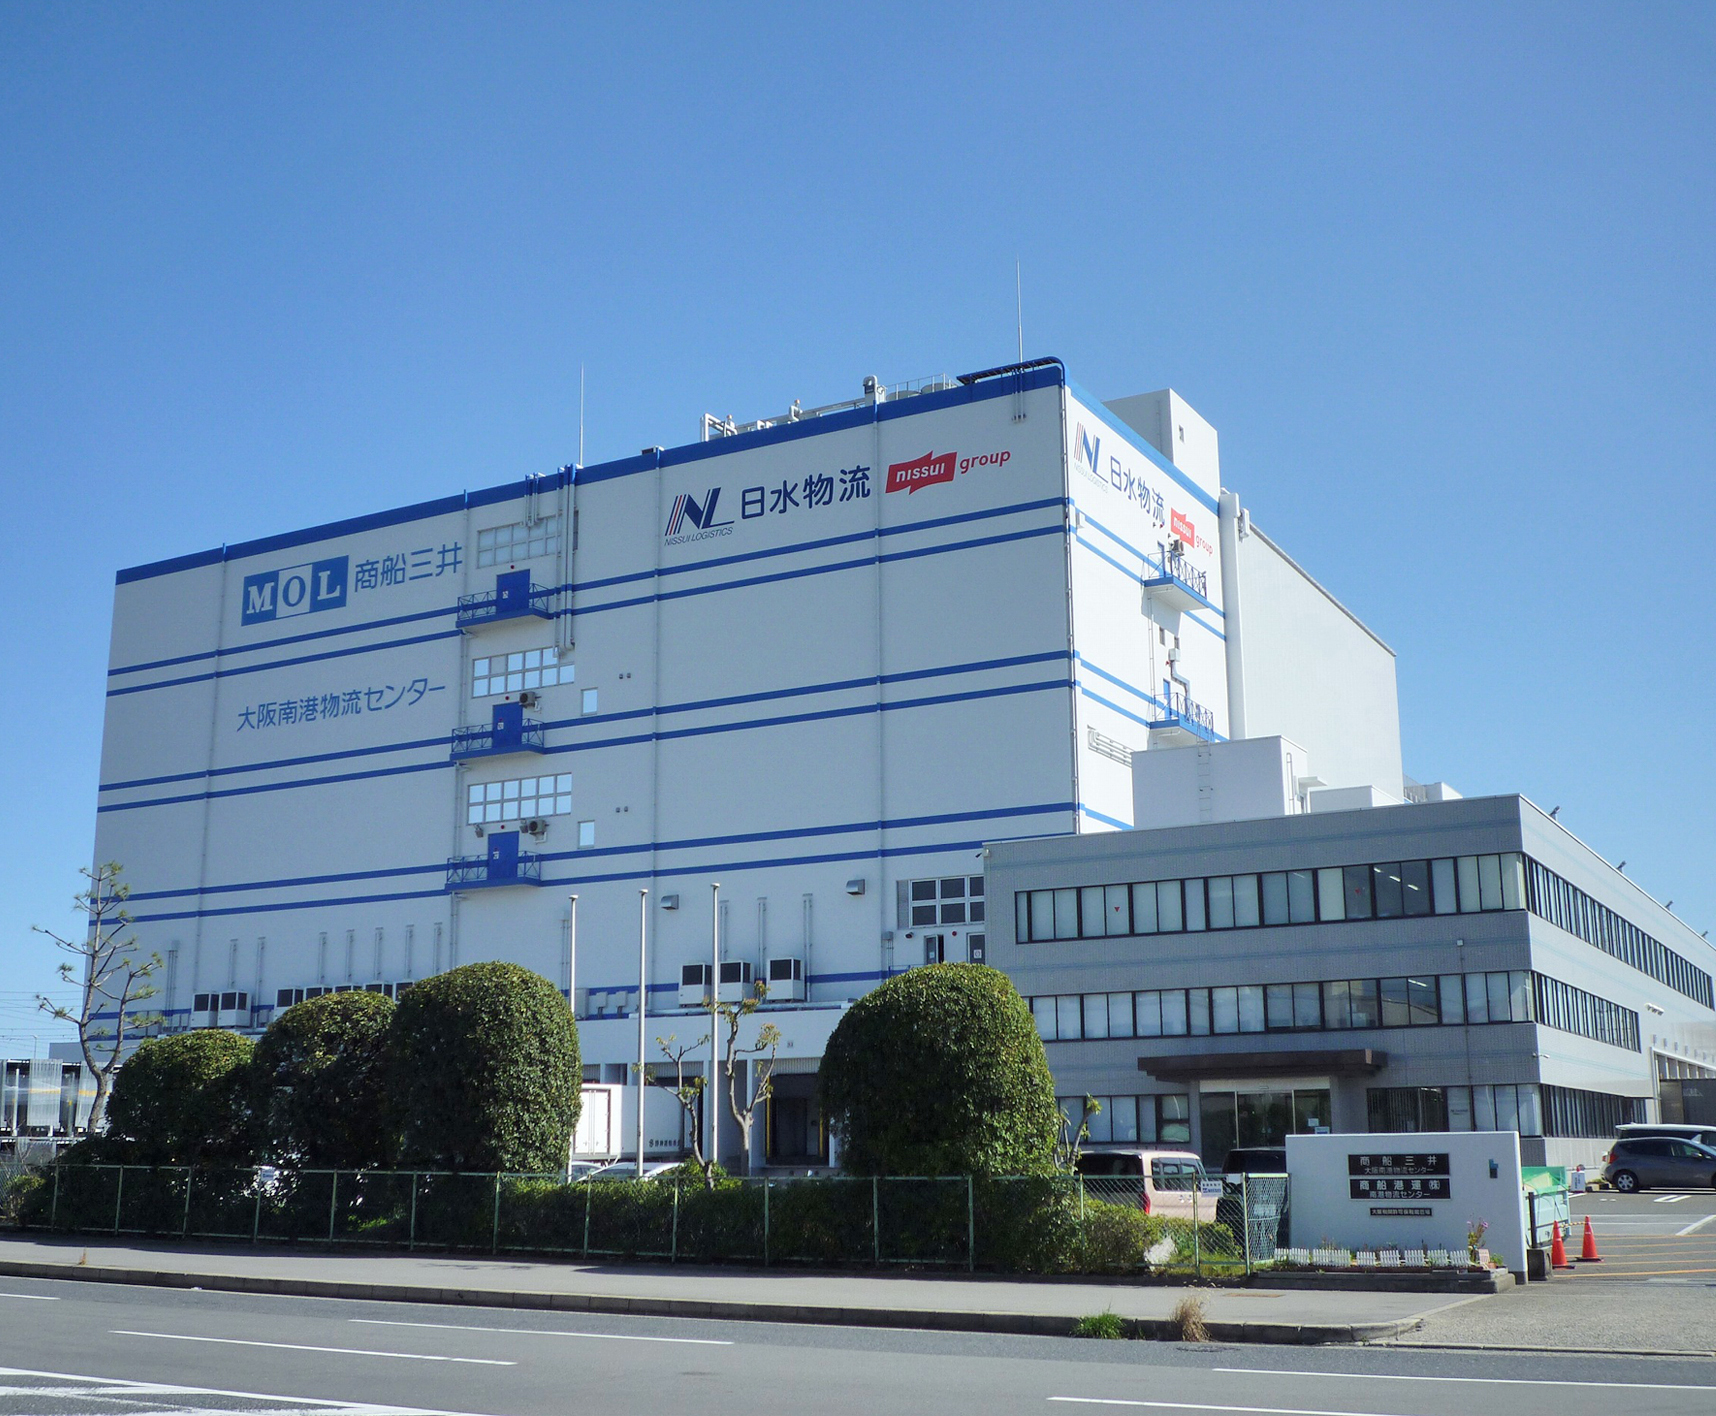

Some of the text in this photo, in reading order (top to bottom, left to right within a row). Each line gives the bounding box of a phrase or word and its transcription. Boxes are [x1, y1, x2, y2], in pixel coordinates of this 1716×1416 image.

[896, 450, 1011, 482] nissui group
[741, 465, 871, 520] 日水物流
[1110, 455, 1165, 525] 日水物流
[664, 527, 734, 546] NISSUI LOGISTICS
[1196, 535, 1214, 557] group
[354, 542, 463, 592] 商船三井
[246, 570, 341, 614] MOL
[237, 678, 446, 732] 大阪南港物流センター
[1360, 1155, 1437, 1166] 商船三井
